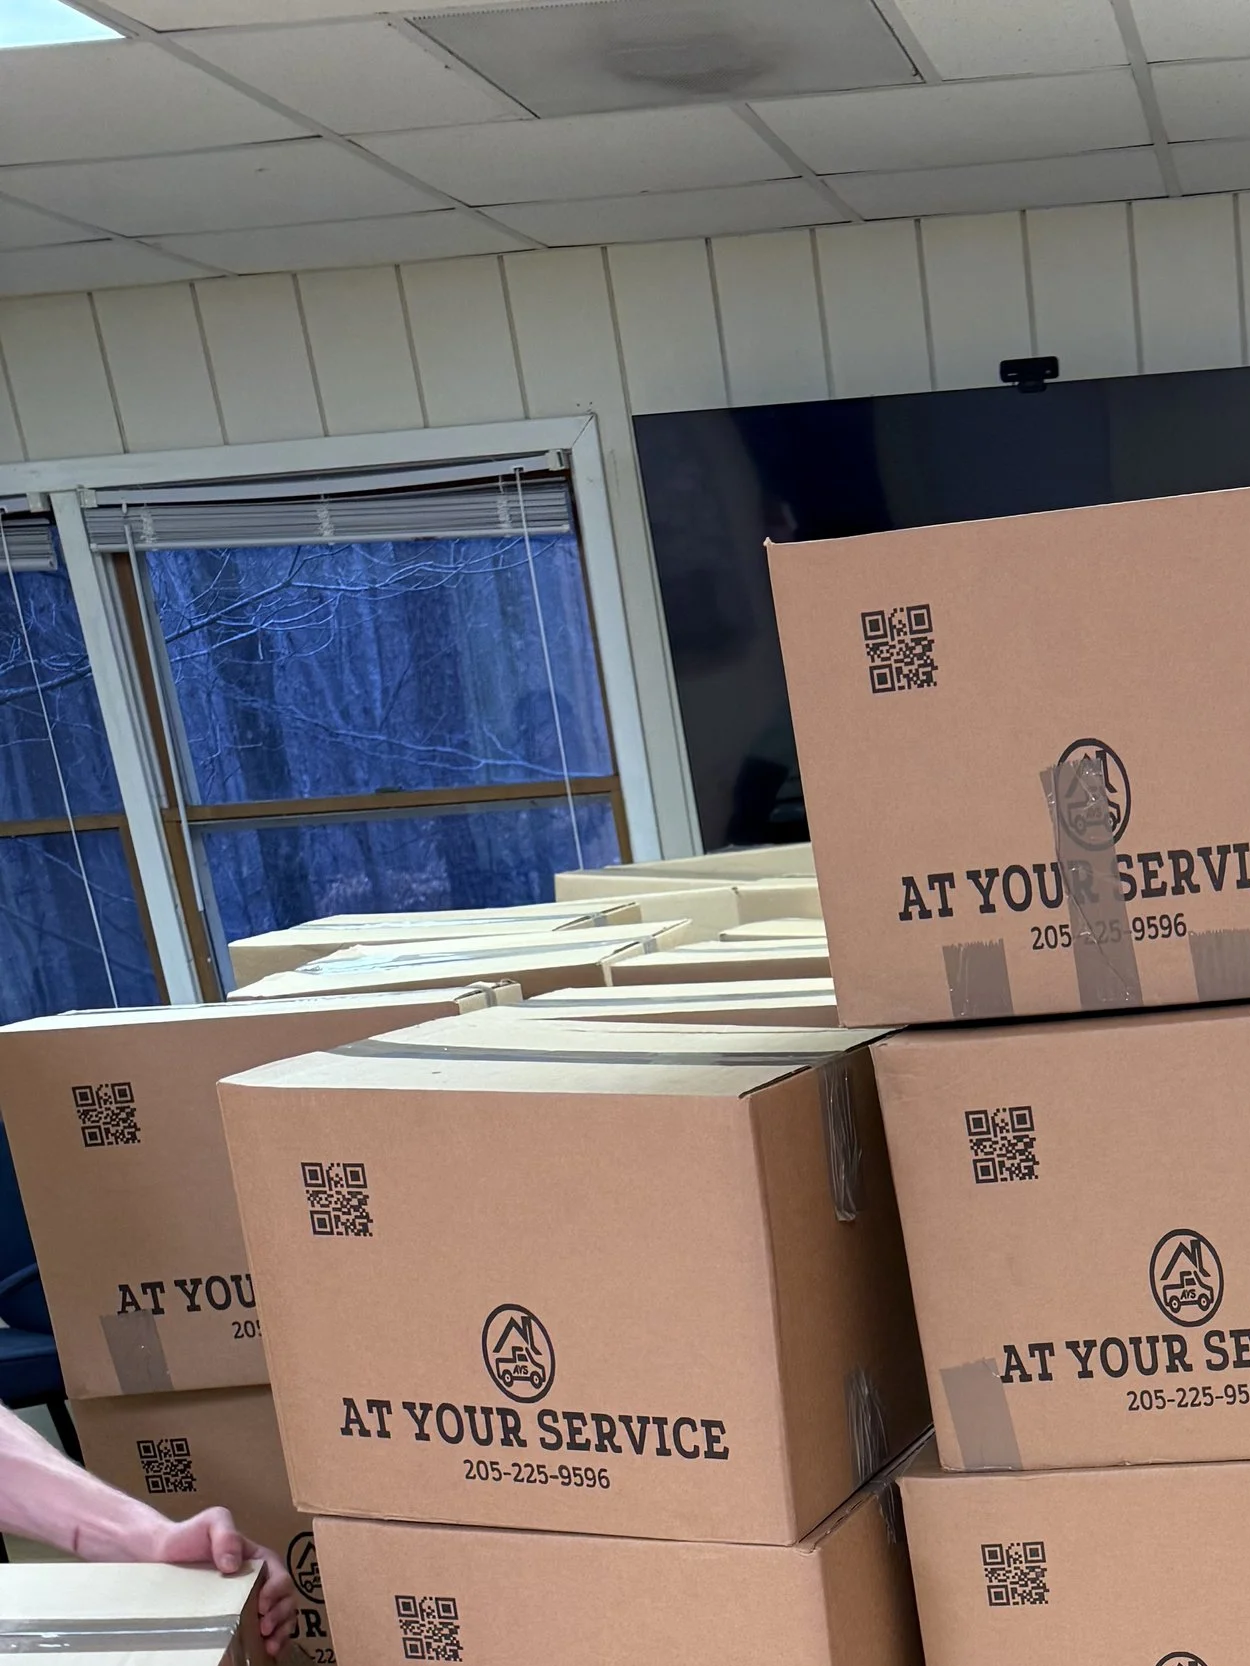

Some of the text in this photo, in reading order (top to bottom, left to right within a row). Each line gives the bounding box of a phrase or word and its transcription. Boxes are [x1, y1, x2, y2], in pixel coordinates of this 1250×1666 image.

[899, 872, 956, 921] AT
[117, 1283, 165, 1315] AT
[1180, 1289, 1196, 1299] AYS
[513, 1365, 529, 1375] AYS
[1000, 1342, 1055, 1384] AT
[1065, 1334, 1193, 1379] YOUR
[340, 1398, 729, 1460] AT YOUR SERVICE
[464, 1459, 610, 1489] 205-225-9596
